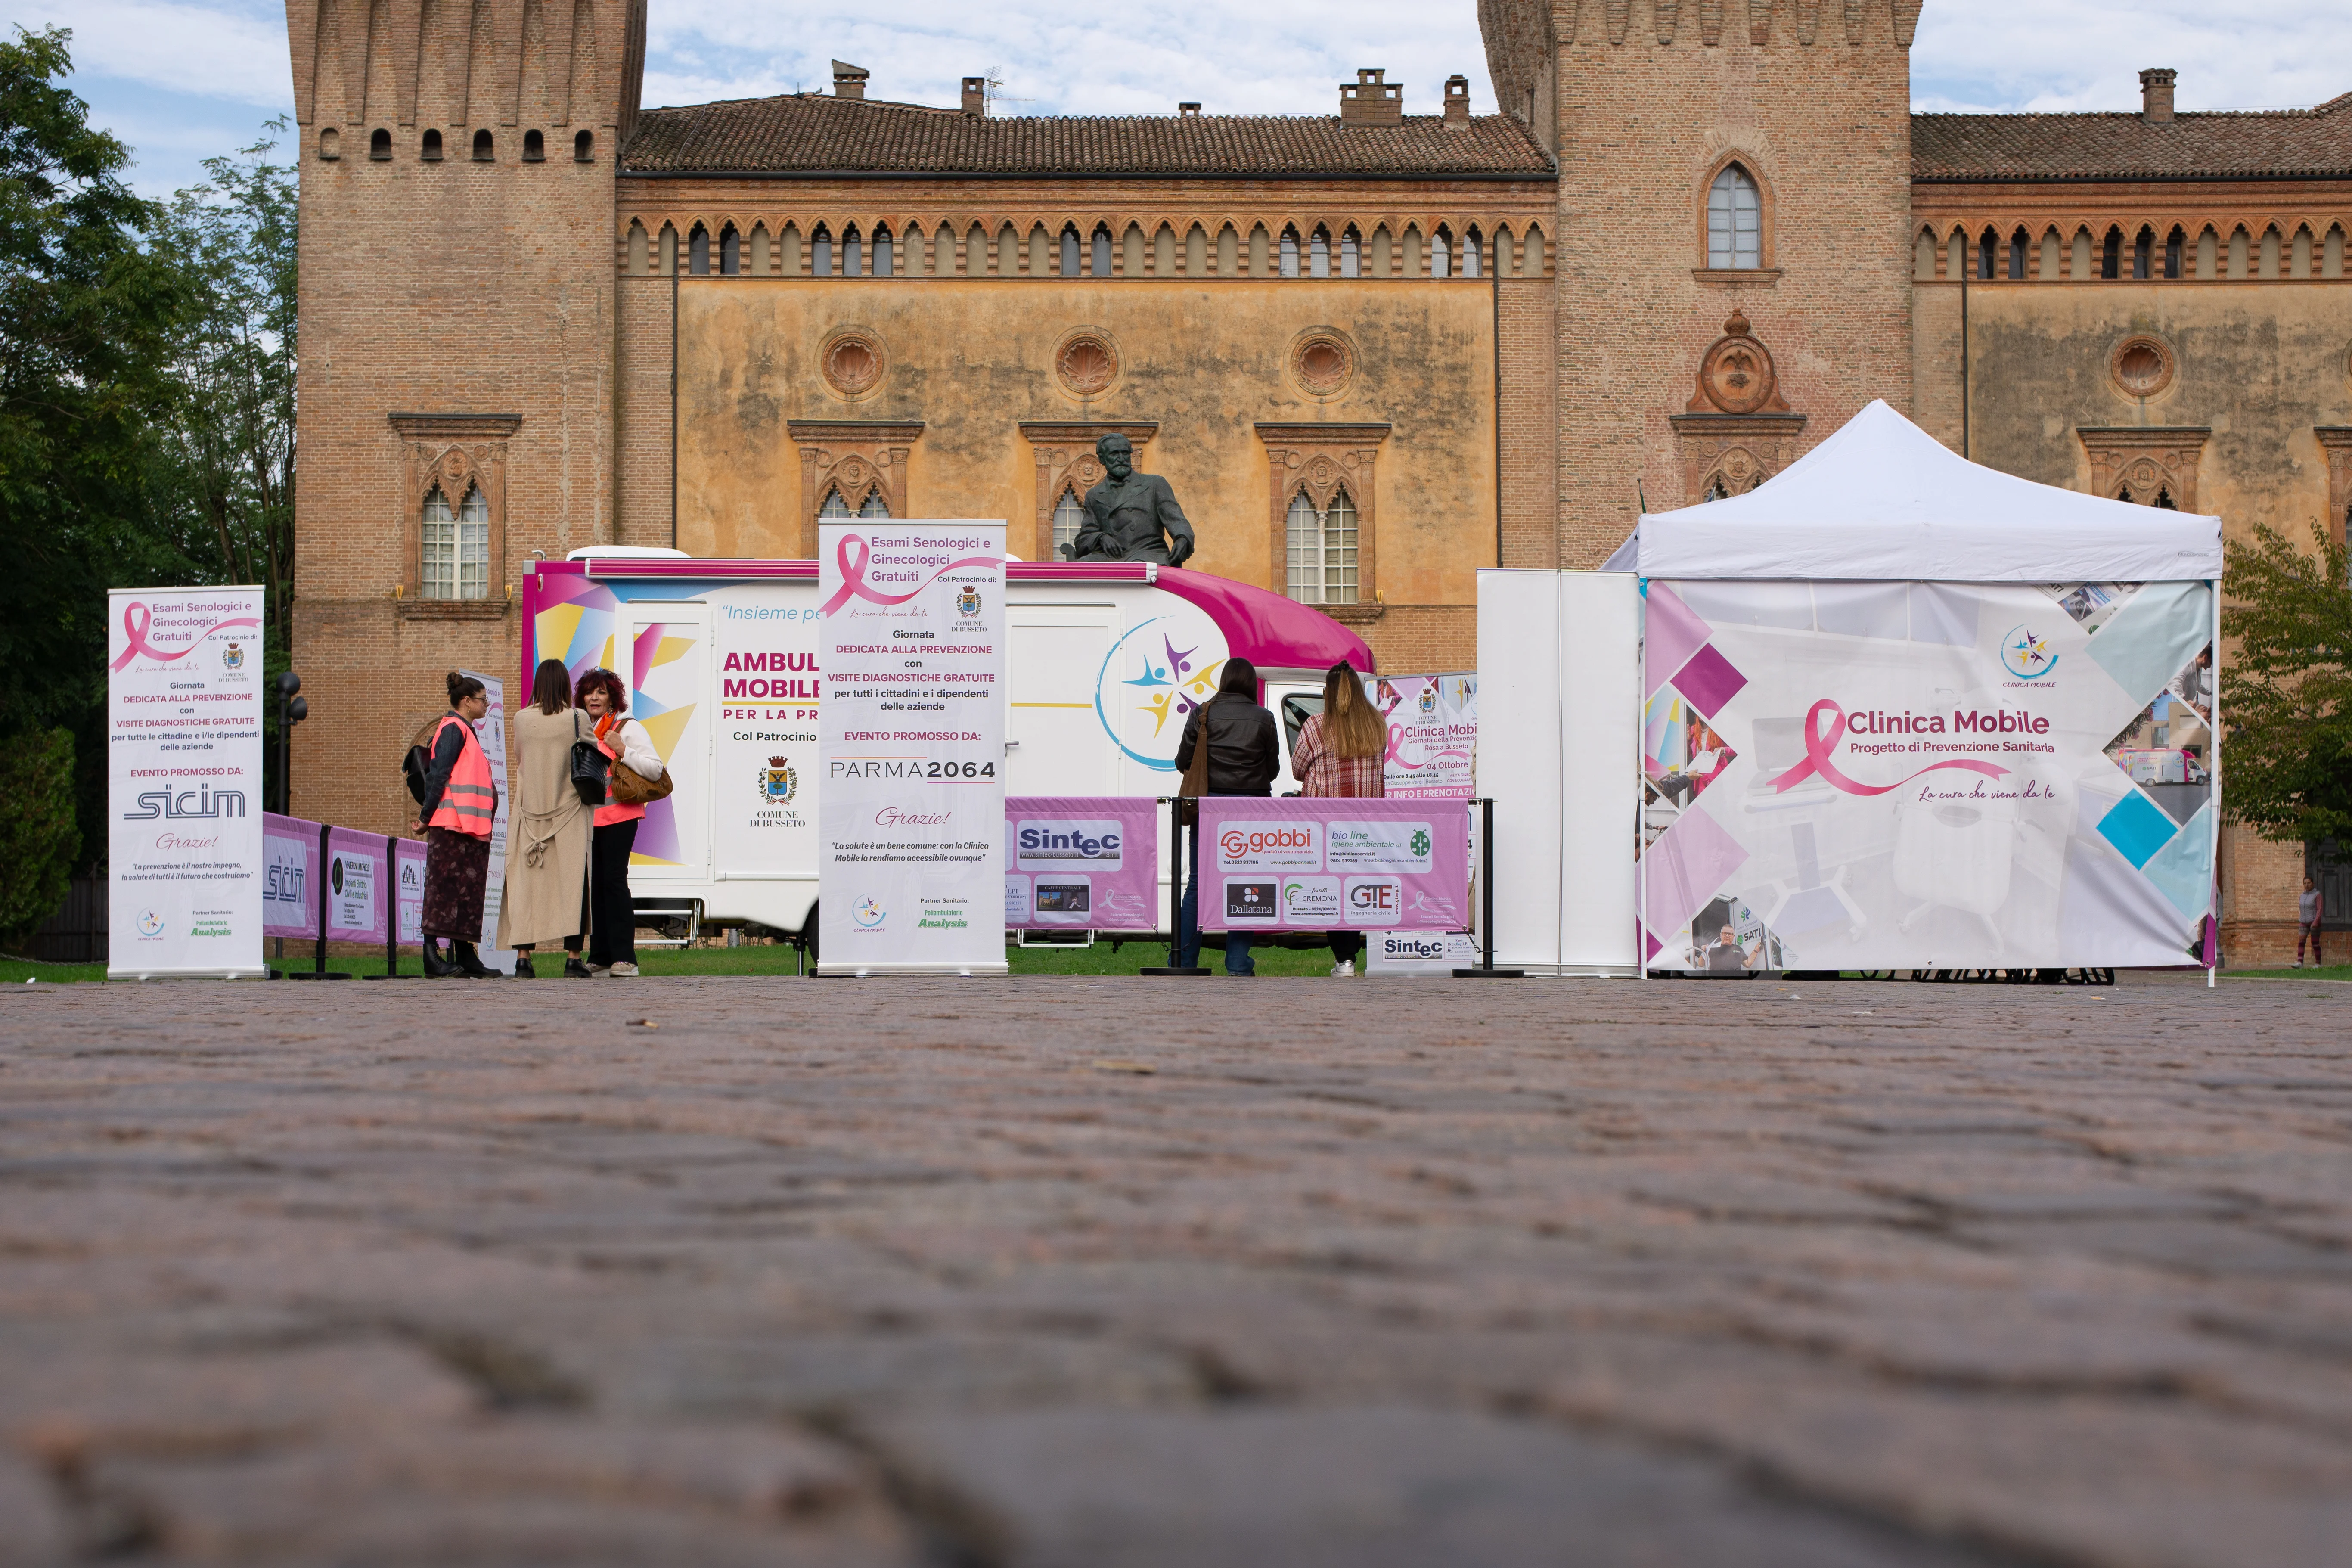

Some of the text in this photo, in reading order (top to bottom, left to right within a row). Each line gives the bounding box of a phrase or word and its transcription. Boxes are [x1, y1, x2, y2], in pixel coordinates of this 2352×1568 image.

[152, 603, 184, 612] Esami
[187, 601, 242, 613] Senologici
[152, 616, 217, 627] Ginecologici
[152, 631, 192, 641] Gratuiti
[893, 630, 934, 639] Giornata
[836, 645, 992, 654] DEDICATA ALLA PREVENZIONE
[723, 652, 820, 672] AMBUL
[828, 673, 995, 683] VISITE DIAGNOSTICHE GRATUITE
[723, 709, 819, 720] PER LA PR
[1847, 709, 2050, 735] Clinica Mobile
[1405, 723, 1477, 737] Clinica Mobi
[112, 733, 125, 742] per
[127, 732, 147, 741] tutte
[158, 732, 193, 740] cittadine
[202, 731, 214, 739] i/le
[216, 730, 259, 740] dipendenti
[733, 731, 817, 742] Col Patrocinio
[844, 731, 981, 741] EVENTO PROMOSSO DA:
[1850, 741, 2054, 755] Progetto di Prevenzione Sanitaria
[1918, 780, 2055, 802] La cura che viene da te
[757, 810, 798, 819] COMUNE
[750, 819, 806, 828] DI BUSSETO
[1250, 829, 1310, 852] gobbi
[1332, 831, 1368, 839] bio line
[156, 832, 219, 851] Grazie!
[845, 842, 869, 850] salute
[870, 842, 875, 850] è
[887, 842, 906, 850] bene
[963, 841, 989, 850] Clinica
[1019, 829, 1120, 856] Sintec
[835, 854, 860, 863] Mobile
[861, 854, 868, 863] la
[869, 854, 906, 863] rendiamo
[906, 854, 949, 862] accessibile
[1351, 885, 1392, 908] GTE
[1231, 905, 1272, 913] Dallatana
[190, 927, 233, 938] Analysis
[1744, 928, 1761, 941] SATI
[1384, 939, 1442, 956] Sintec
